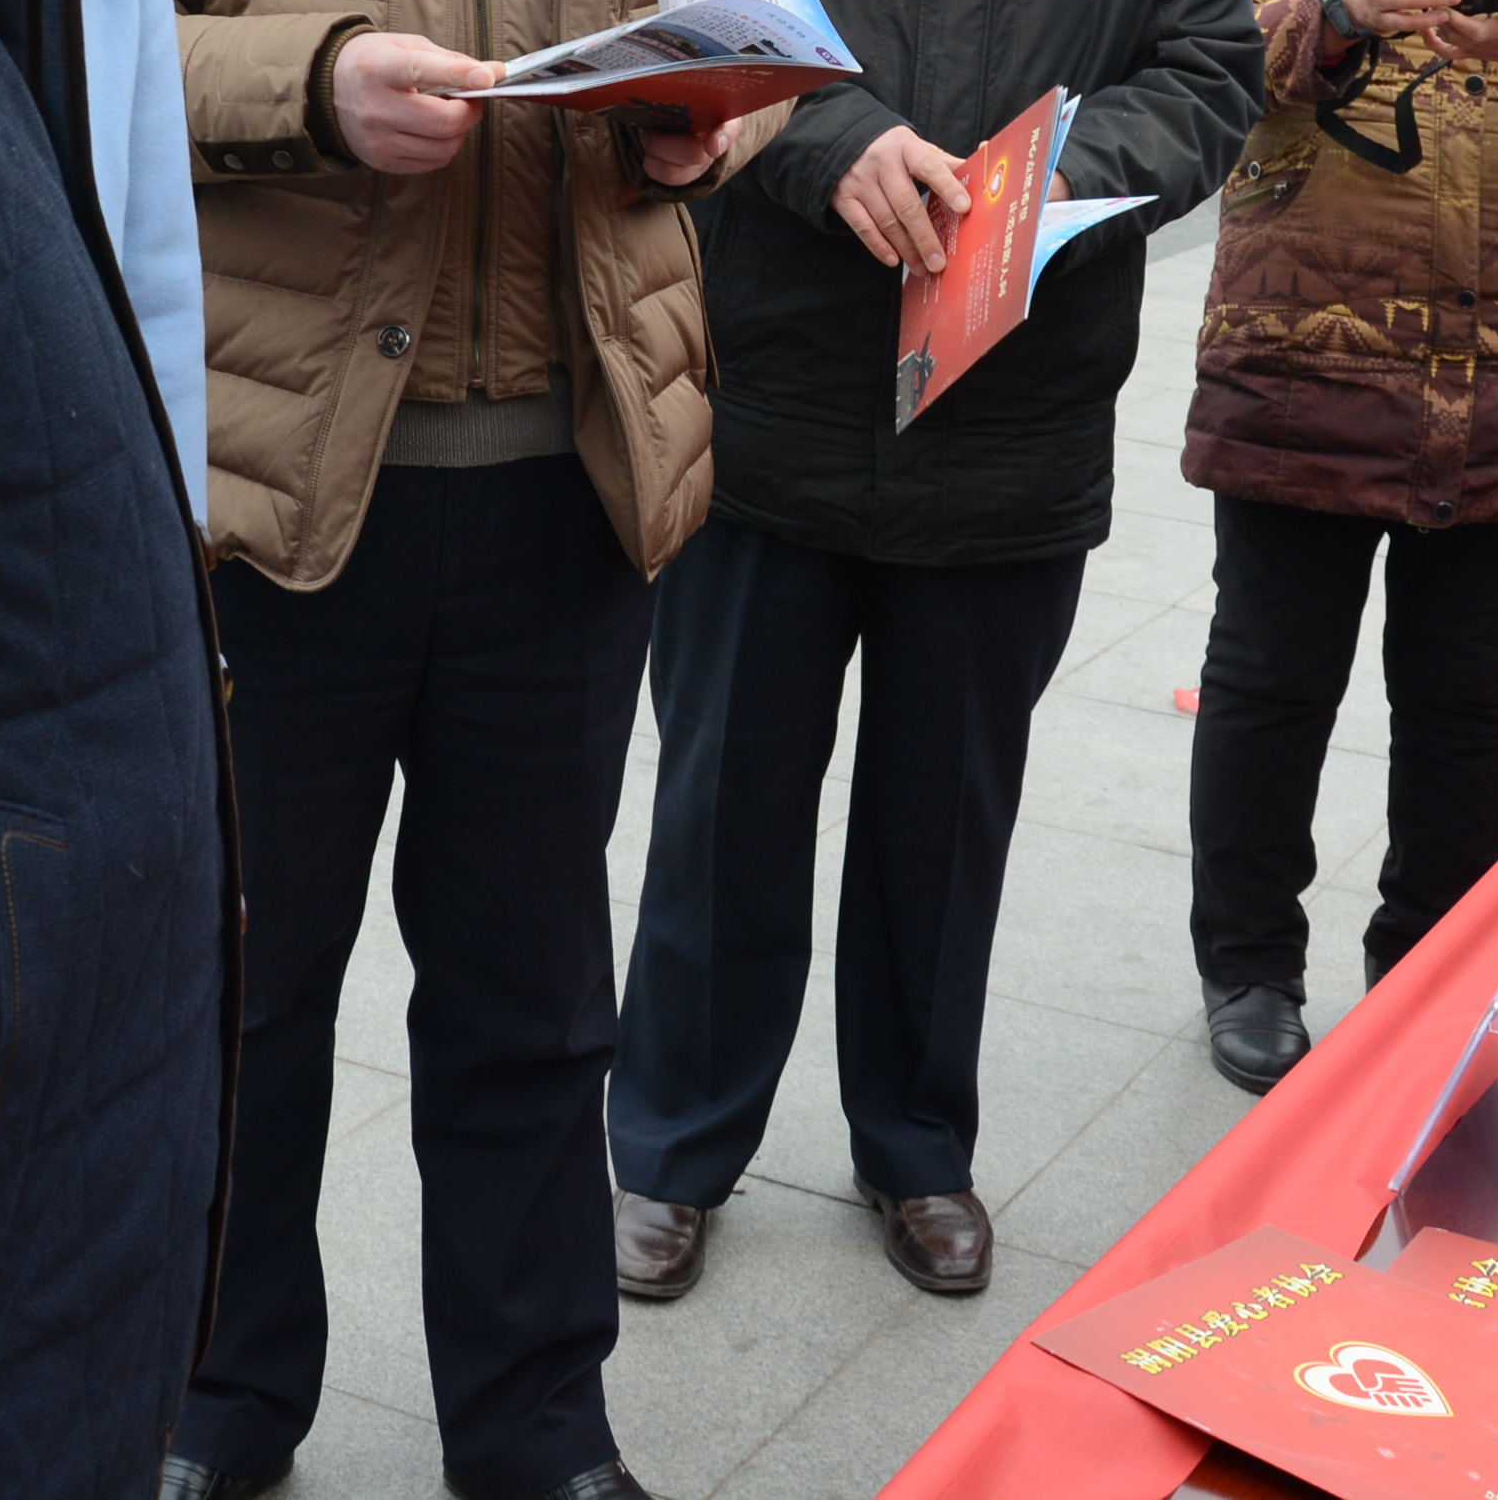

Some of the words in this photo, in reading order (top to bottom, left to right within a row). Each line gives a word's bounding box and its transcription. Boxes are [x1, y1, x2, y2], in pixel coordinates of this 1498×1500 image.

[1120, 1262, 1344, 1375] 涡阳县爱心者协会
